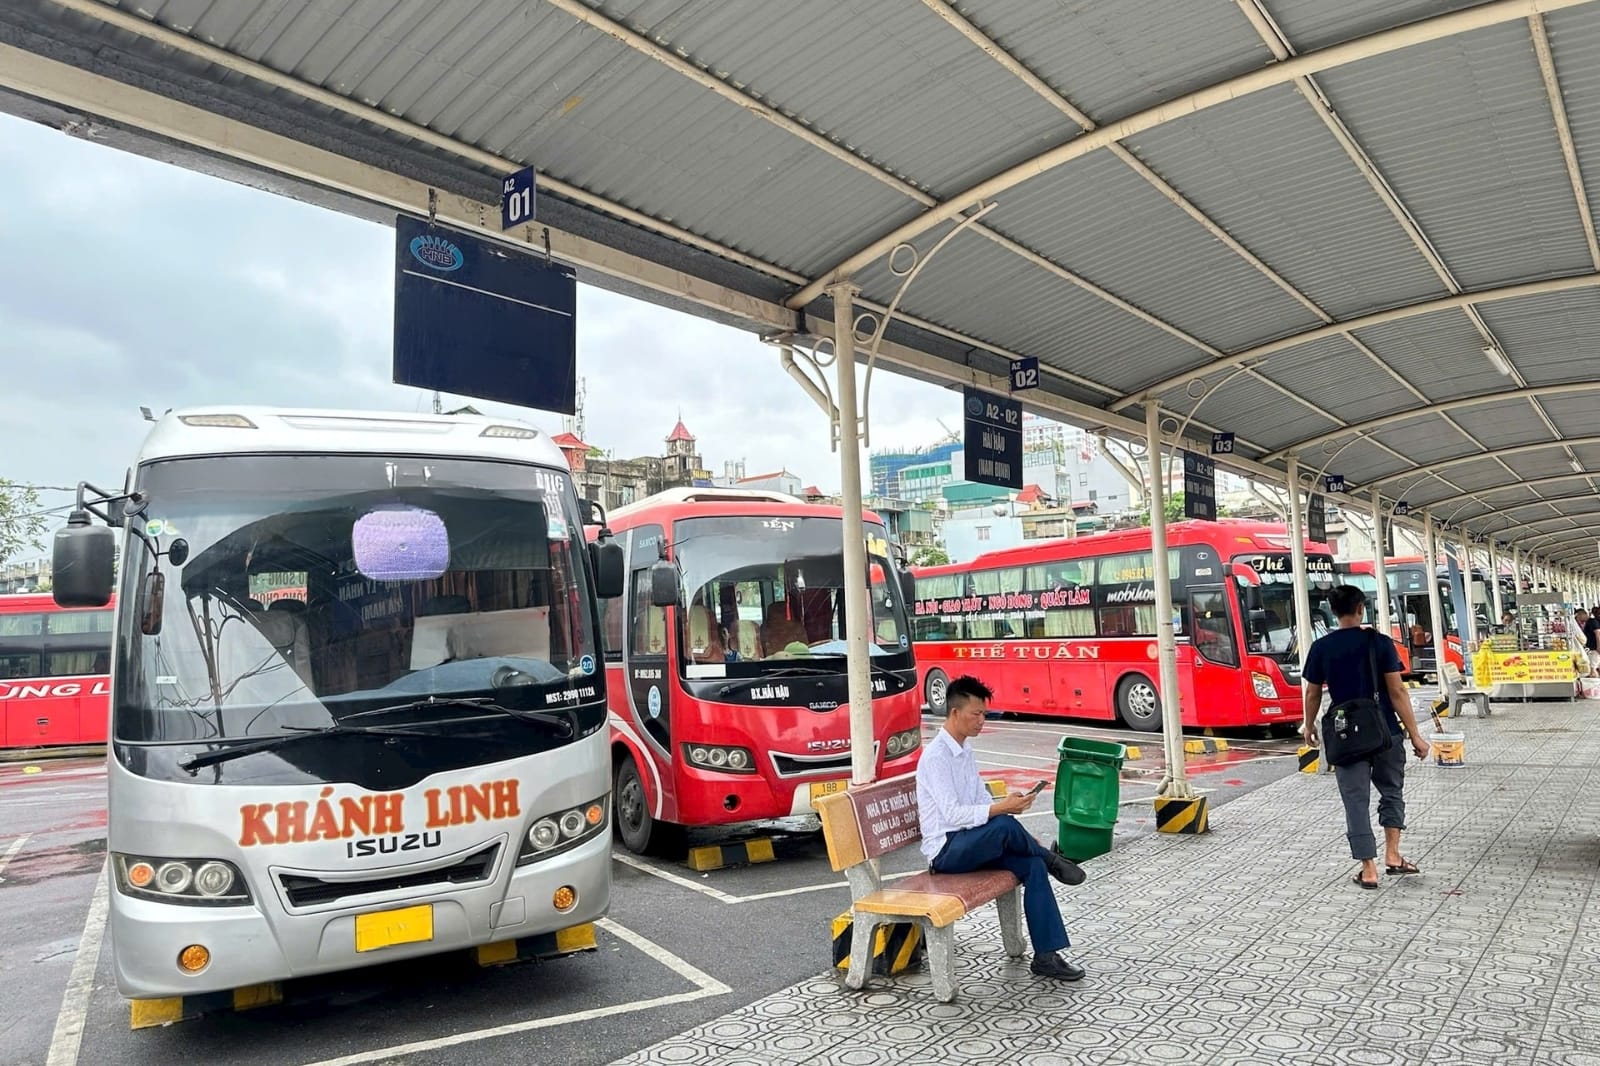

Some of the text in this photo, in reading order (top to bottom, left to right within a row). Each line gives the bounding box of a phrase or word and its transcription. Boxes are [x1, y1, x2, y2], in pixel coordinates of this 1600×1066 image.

[504, 178, 515, 194] A2
[510, 187, 530, 221] 01
[1011, 362, 1021, 371] A2
[1015, 369, 1038, 388] 02
[1215, 440, 1233, 452] 03
[1330, 482, 1344, 491] 04
[1251, 556, 1285, 571] Thế
[1068, 586, 1091, 605] LÂM
[953, 641, 1101, 659] THẾ TUẤN
[808, 738, 852, 752] ISUZU
[238, 780, 521, 847] KHÁNH LINH
[879, 799, 890, 815] XE
[347, 831, 442, 859] ISUZU
